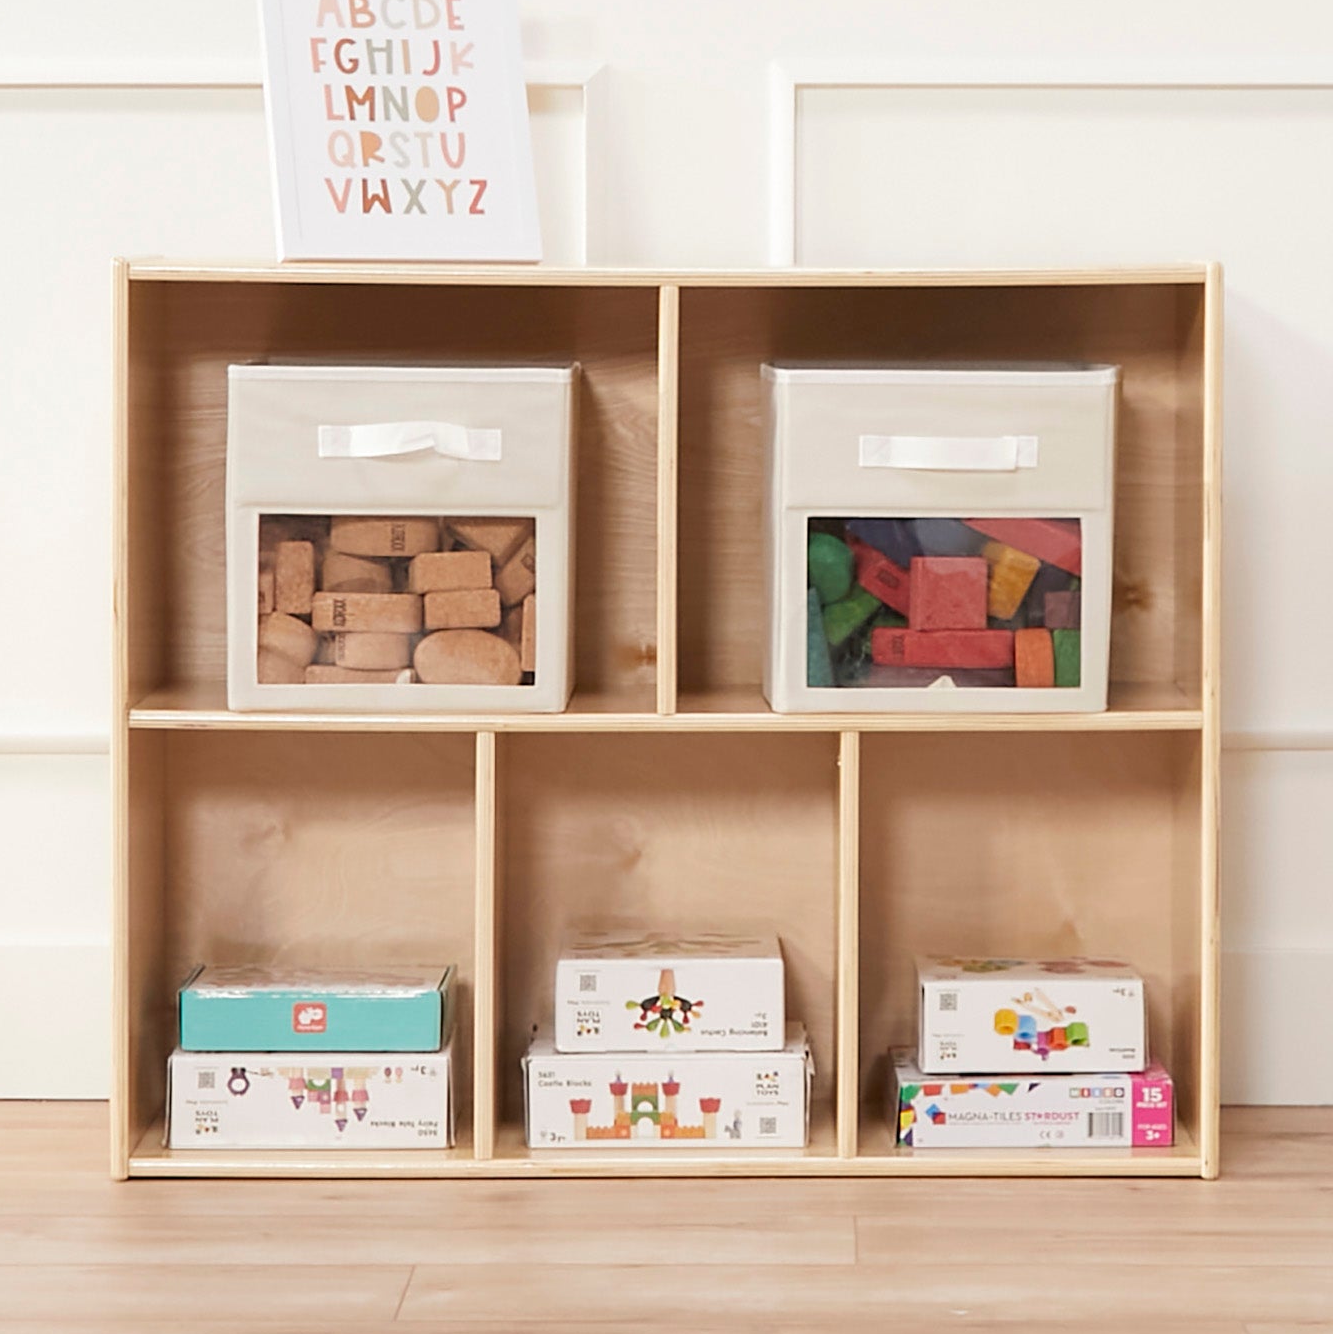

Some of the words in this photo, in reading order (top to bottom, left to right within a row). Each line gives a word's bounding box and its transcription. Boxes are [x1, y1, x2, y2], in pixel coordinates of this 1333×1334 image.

[310, 37, 475, 76] FGHIJK
[324, 84, 467, 123] LMNOP
[327, 129, 466, 169] QRSTU
[324, 178, 488, 215] VWXYZ
[1141, 1087, 1163, 1103] 15
